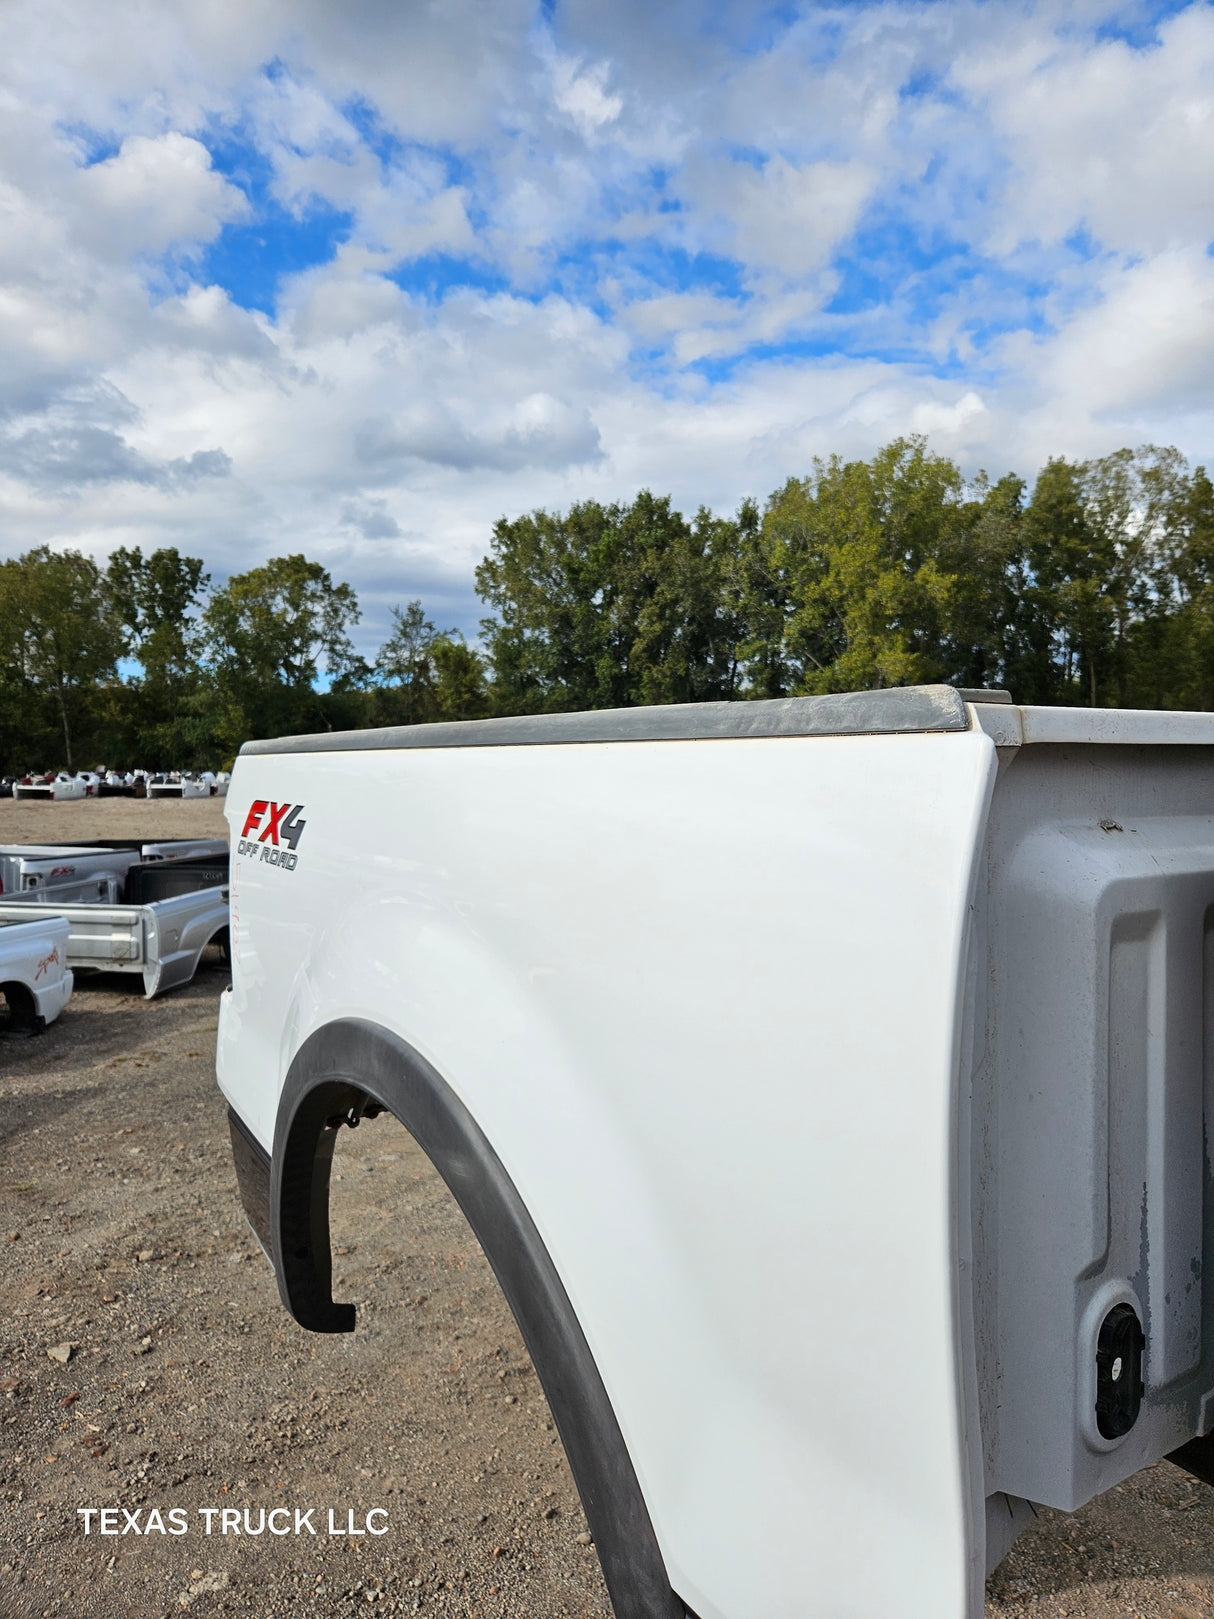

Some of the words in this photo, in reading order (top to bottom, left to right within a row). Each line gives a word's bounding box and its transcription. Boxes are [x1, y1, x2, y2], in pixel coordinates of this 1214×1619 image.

[241, 799, 306, 850] FX4
[237, 840, 259, 858] OFF
[260, 846, 298, 871] ROAD
